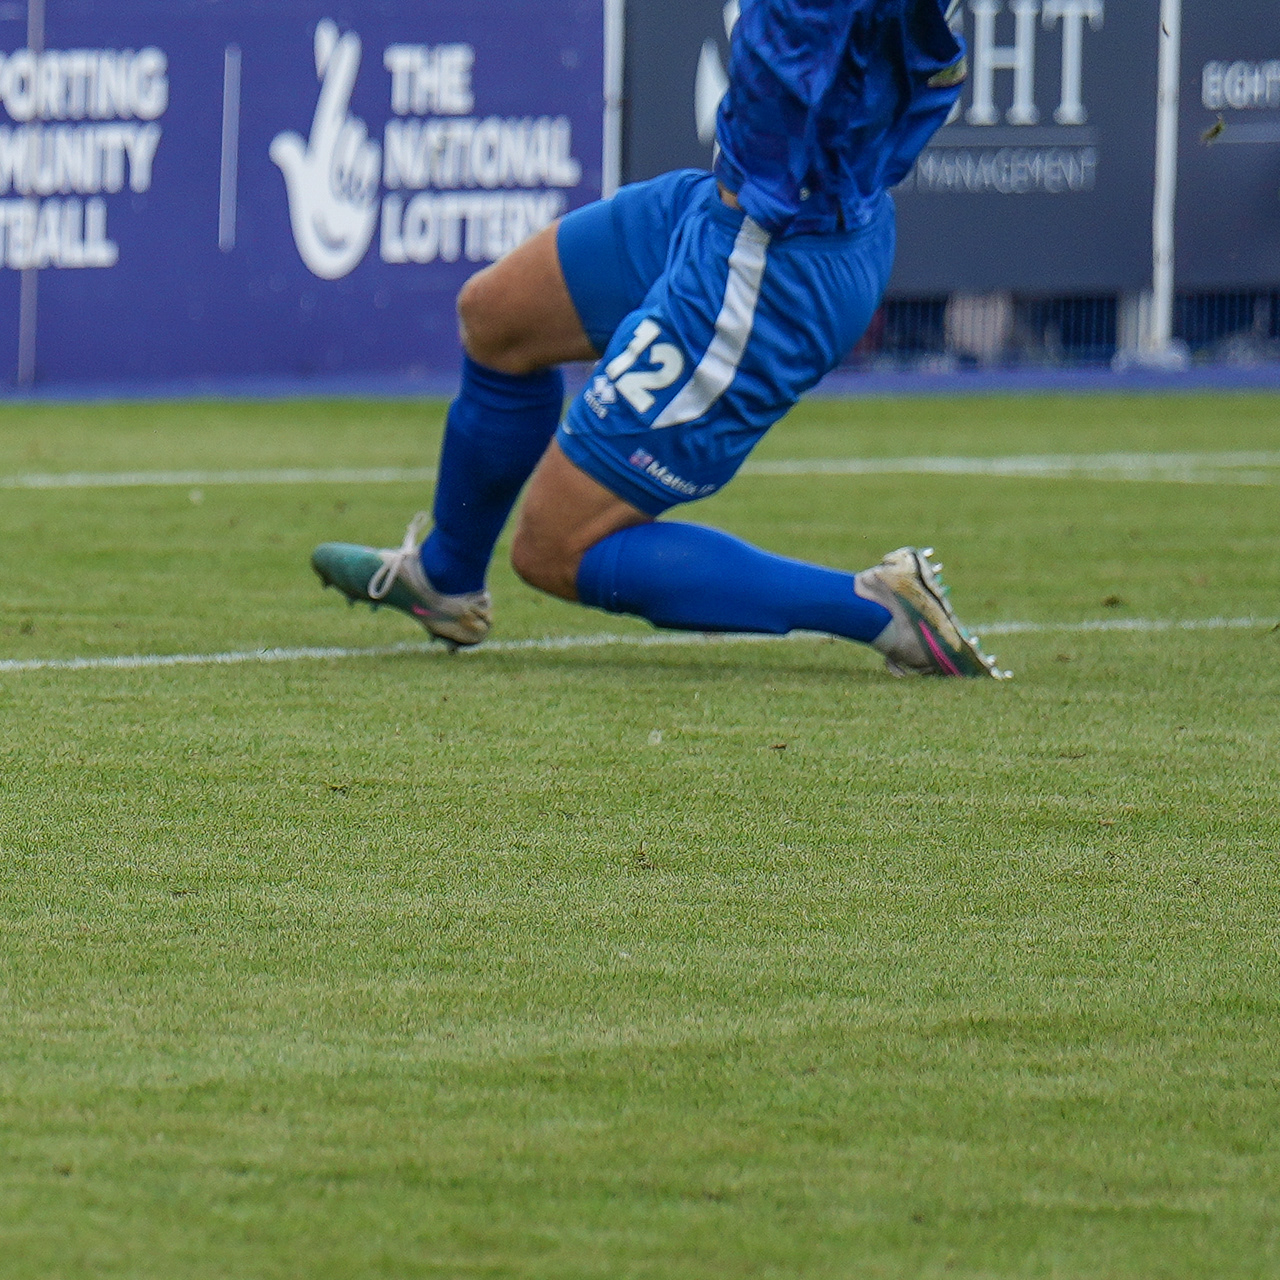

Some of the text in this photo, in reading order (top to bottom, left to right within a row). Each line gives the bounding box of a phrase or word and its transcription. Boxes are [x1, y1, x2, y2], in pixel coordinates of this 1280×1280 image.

[383, 42, 476, 116] THE
[383, 116, 583, 190] NATIONAL
[917, 147, 1097, 194] MANAGEMENT
[605, 318, 684, 414] 12
